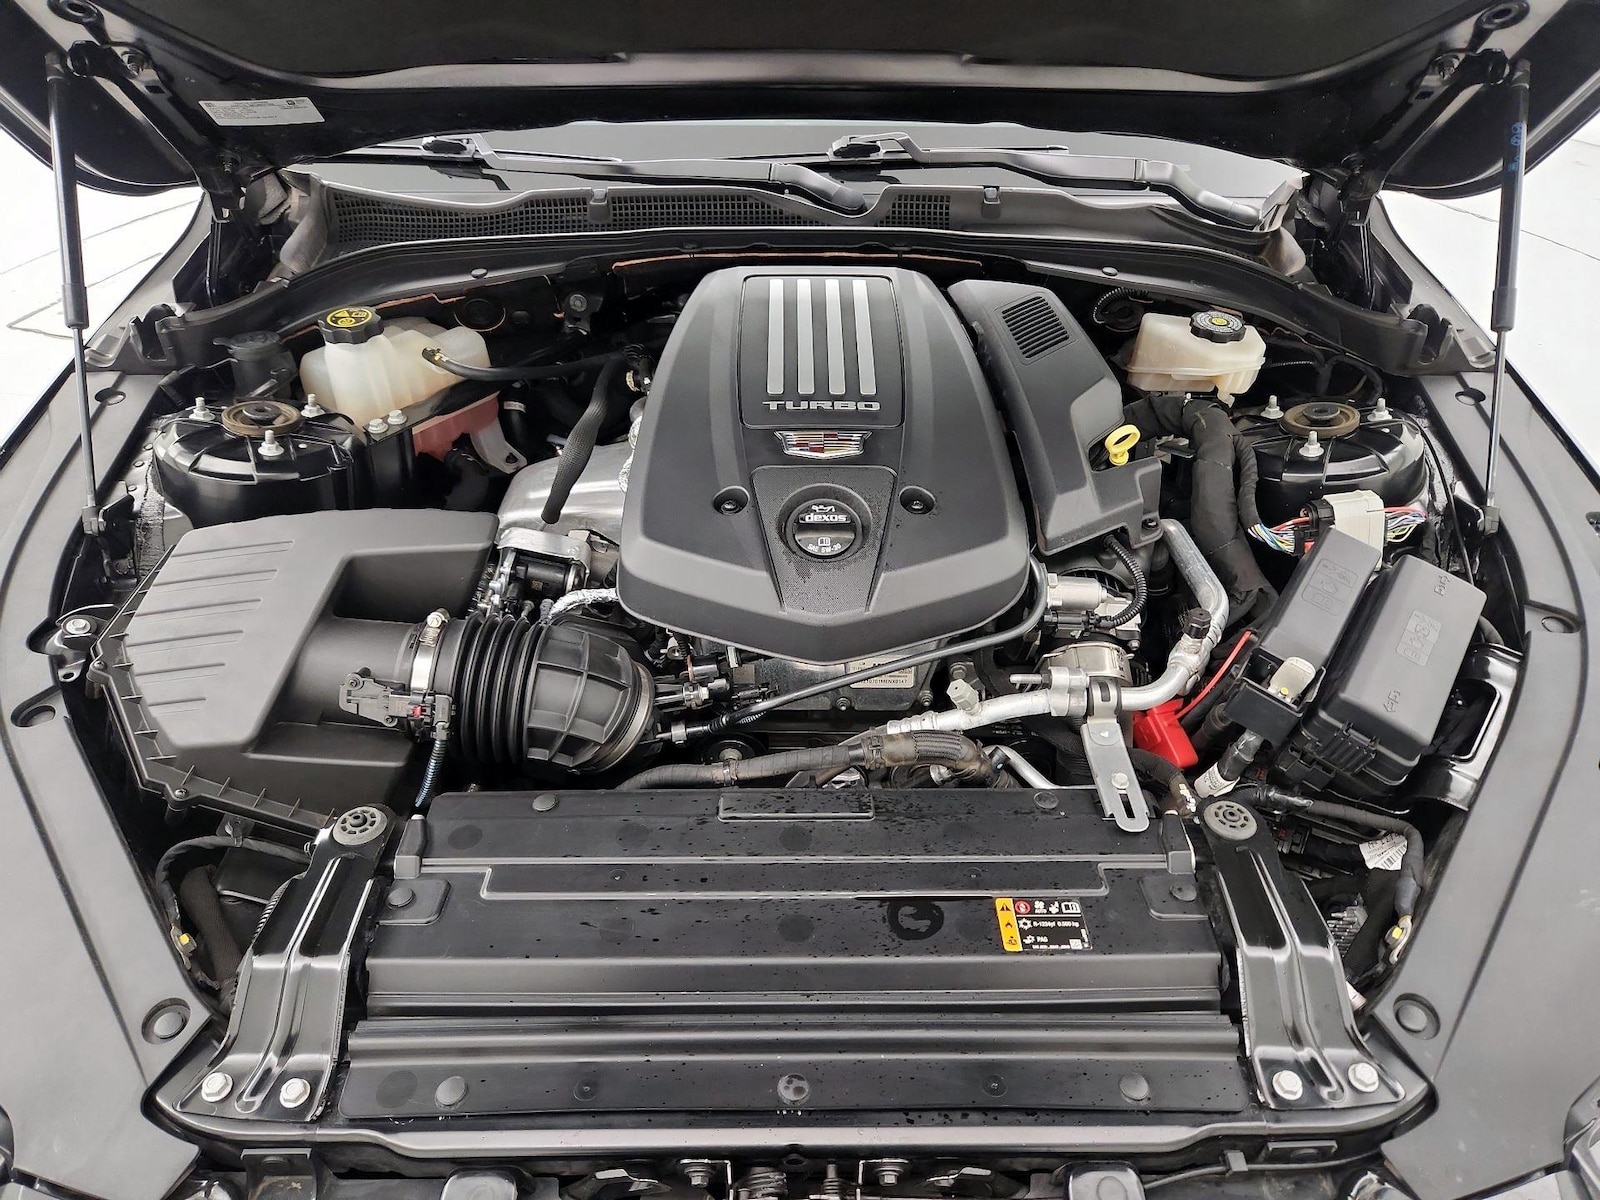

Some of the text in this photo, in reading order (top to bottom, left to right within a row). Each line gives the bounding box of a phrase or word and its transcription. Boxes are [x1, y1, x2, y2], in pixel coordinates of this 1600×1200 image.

[762, 401, 880, 411] TURBO
[805, 513, 847, 522] dexos
[807, 543, 841, 553] SAE 5W-30
